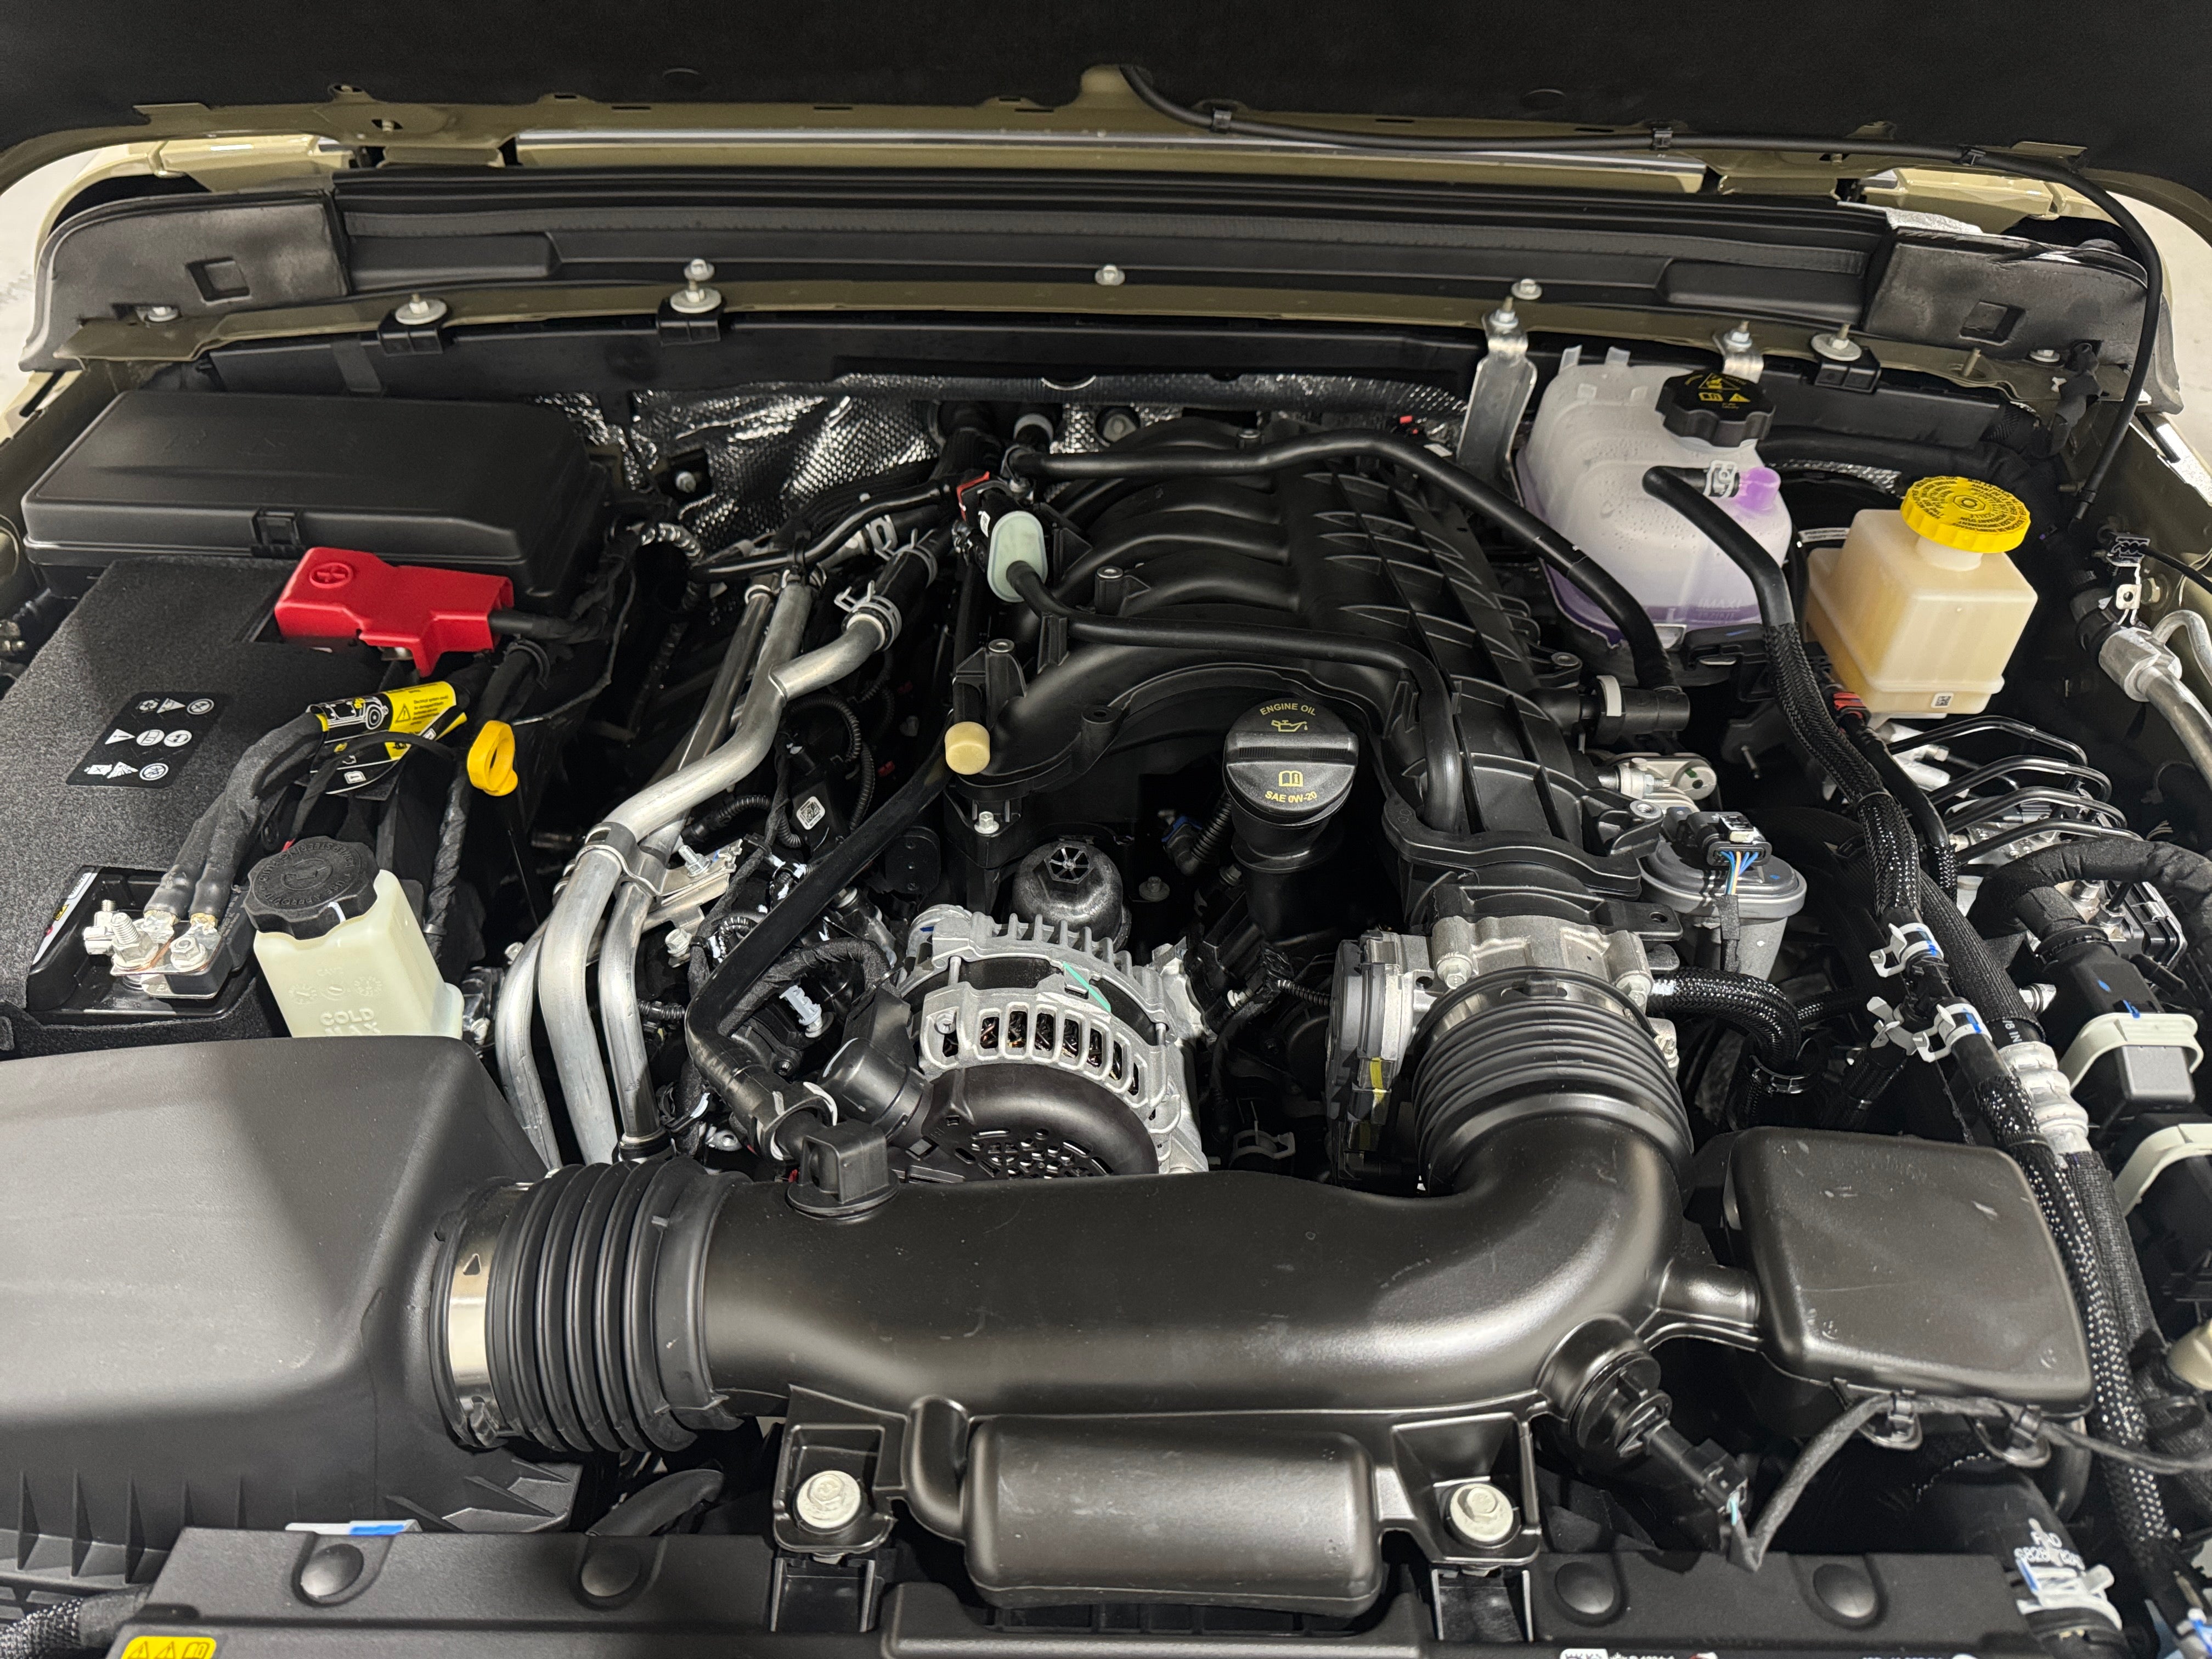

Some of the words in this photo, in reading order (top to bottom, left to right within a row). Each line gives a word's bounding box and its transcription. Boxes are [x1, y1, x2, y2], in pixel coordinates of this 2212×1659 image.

[1260, 703, 1298, 715] ENGINE
[1300, 705, 1316, 715] OIL
[1265, 791, 1285, 803] SAE
[1288, 791, 1317, 803] 0W-20
[279, 842, 332, 862] STEERING
[324, 880, 345, 895] USE
[320, 1008, 375, 1025] COLD
[2008, 1031, 2023, 1043] IN
